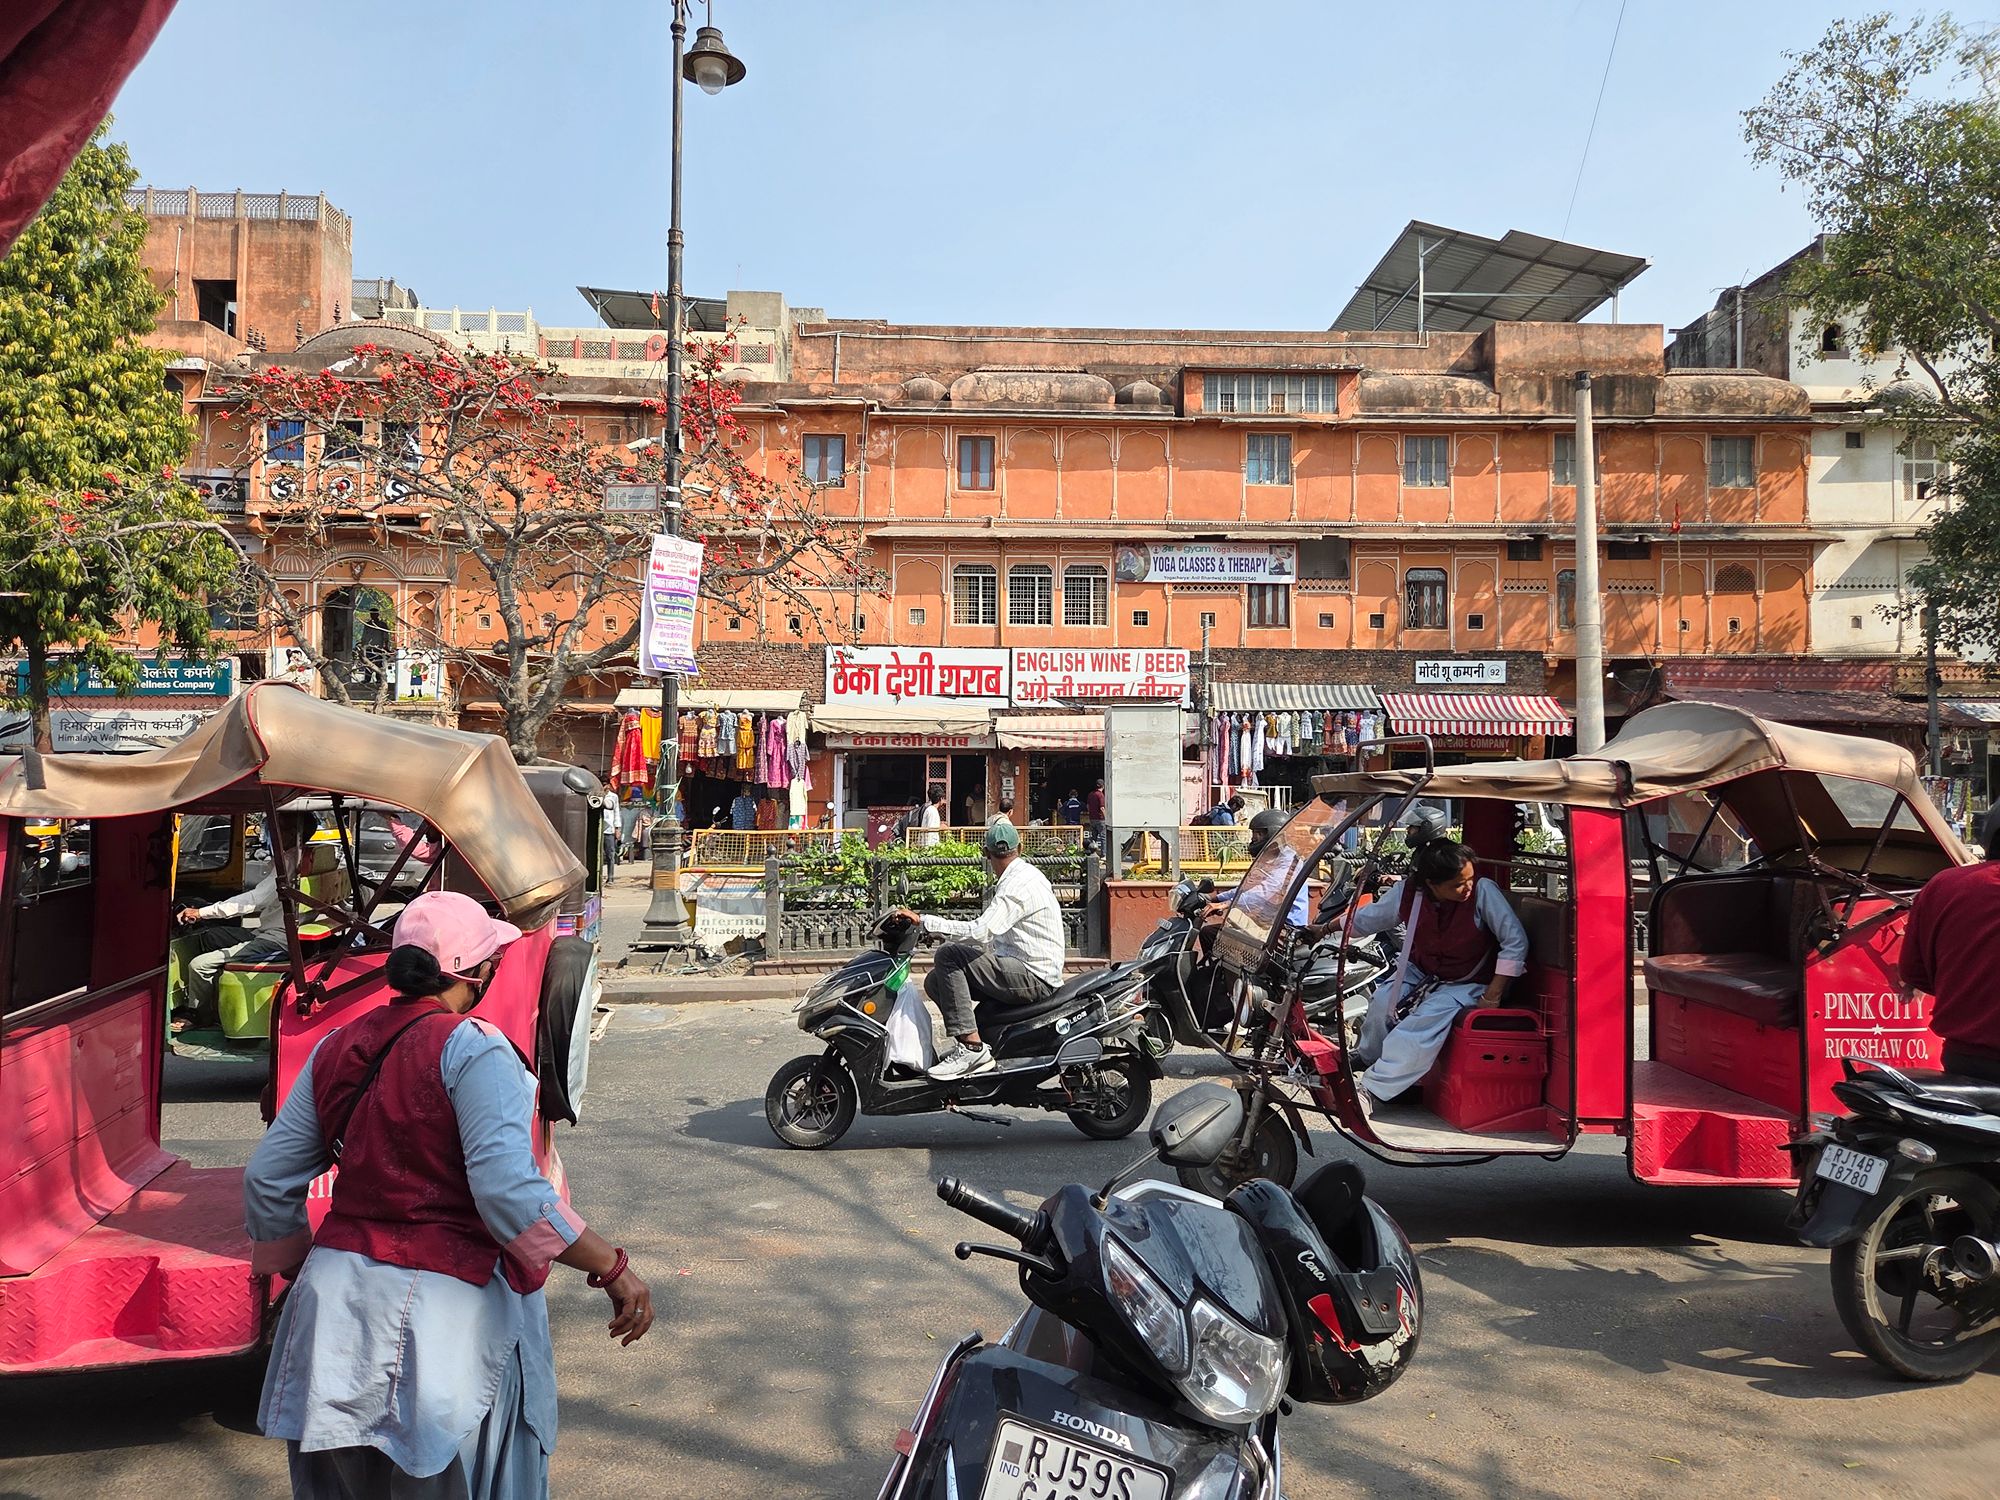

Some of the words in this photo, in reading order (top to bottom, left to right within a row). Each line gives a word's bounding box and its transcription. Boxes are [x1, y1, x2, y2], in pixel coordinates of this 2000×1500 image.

[1153, 556, 1176, 572] YOGA
[1179, 556, 1216, 572] CLASSES
[1219, 557, 1225, 572] &
[1228, 557, 1267, 573] THERAPY
[1017, 652, 1085, 672] ENGLISH
[1091, 653, 1131, 672] WINE
[1145, 653, 1186, 673] BEER
[1418, 662, 1440, 678] मोदी
[1442, 665, 1452, 682] शू
[1453, 662, 1485, 678] कम्पनी
[1490, 668, 1500, 676] 92
[831, 651, 882, 695] ठेका
[885, 651, 936, 697] देशी
[939, 664, 1003, 696] शराब
[134, 680, 172, 689] ellness
[173, 680, 216, 690] Company
[59, 717, 106, 732] हिमालया
[926, 736, 970, 747] शराब
[1470, 738, 1510, 748] COMPANY
[696, 917, 765, 926] Internati
[1824, 992, 1876, 1020] PINK
[1825, 1038, 1902, 1059] RICKSHAW
[1906, 1038, 1929, 1060] CO.
[1832, 1148, 1875, 1173] RJ14B
[1828, 1162, 1869, 1188] T8780
[1051, 1410, 1134, 1452] HONDA
[999, 1460, 1021, 1478] IND
[1024, 1435, 1136, 1500] RJ59S
